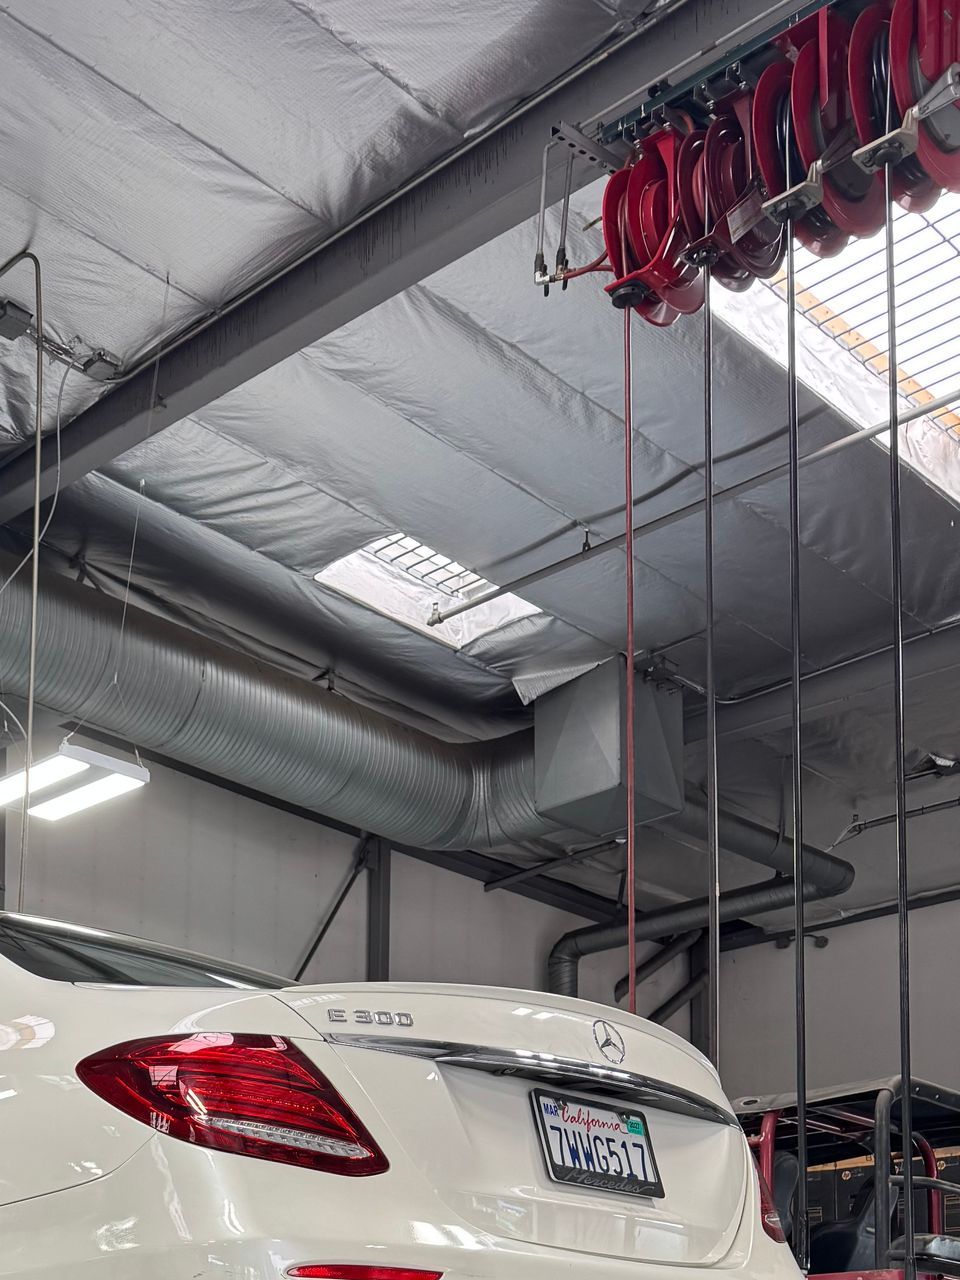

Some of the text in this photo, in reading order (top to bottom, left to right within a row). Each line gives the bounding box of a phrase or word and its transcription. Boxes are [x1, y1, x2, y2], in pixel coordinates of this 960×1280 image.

[327, 1008, 414, 1027] E 300
[543, 1102, 559, 1117] MAR
[561, 1103, 628, 1135] California
[549, 1125, 648, 1182] 7WWG517
[563, 1169, 655, 1193] Mercedes
